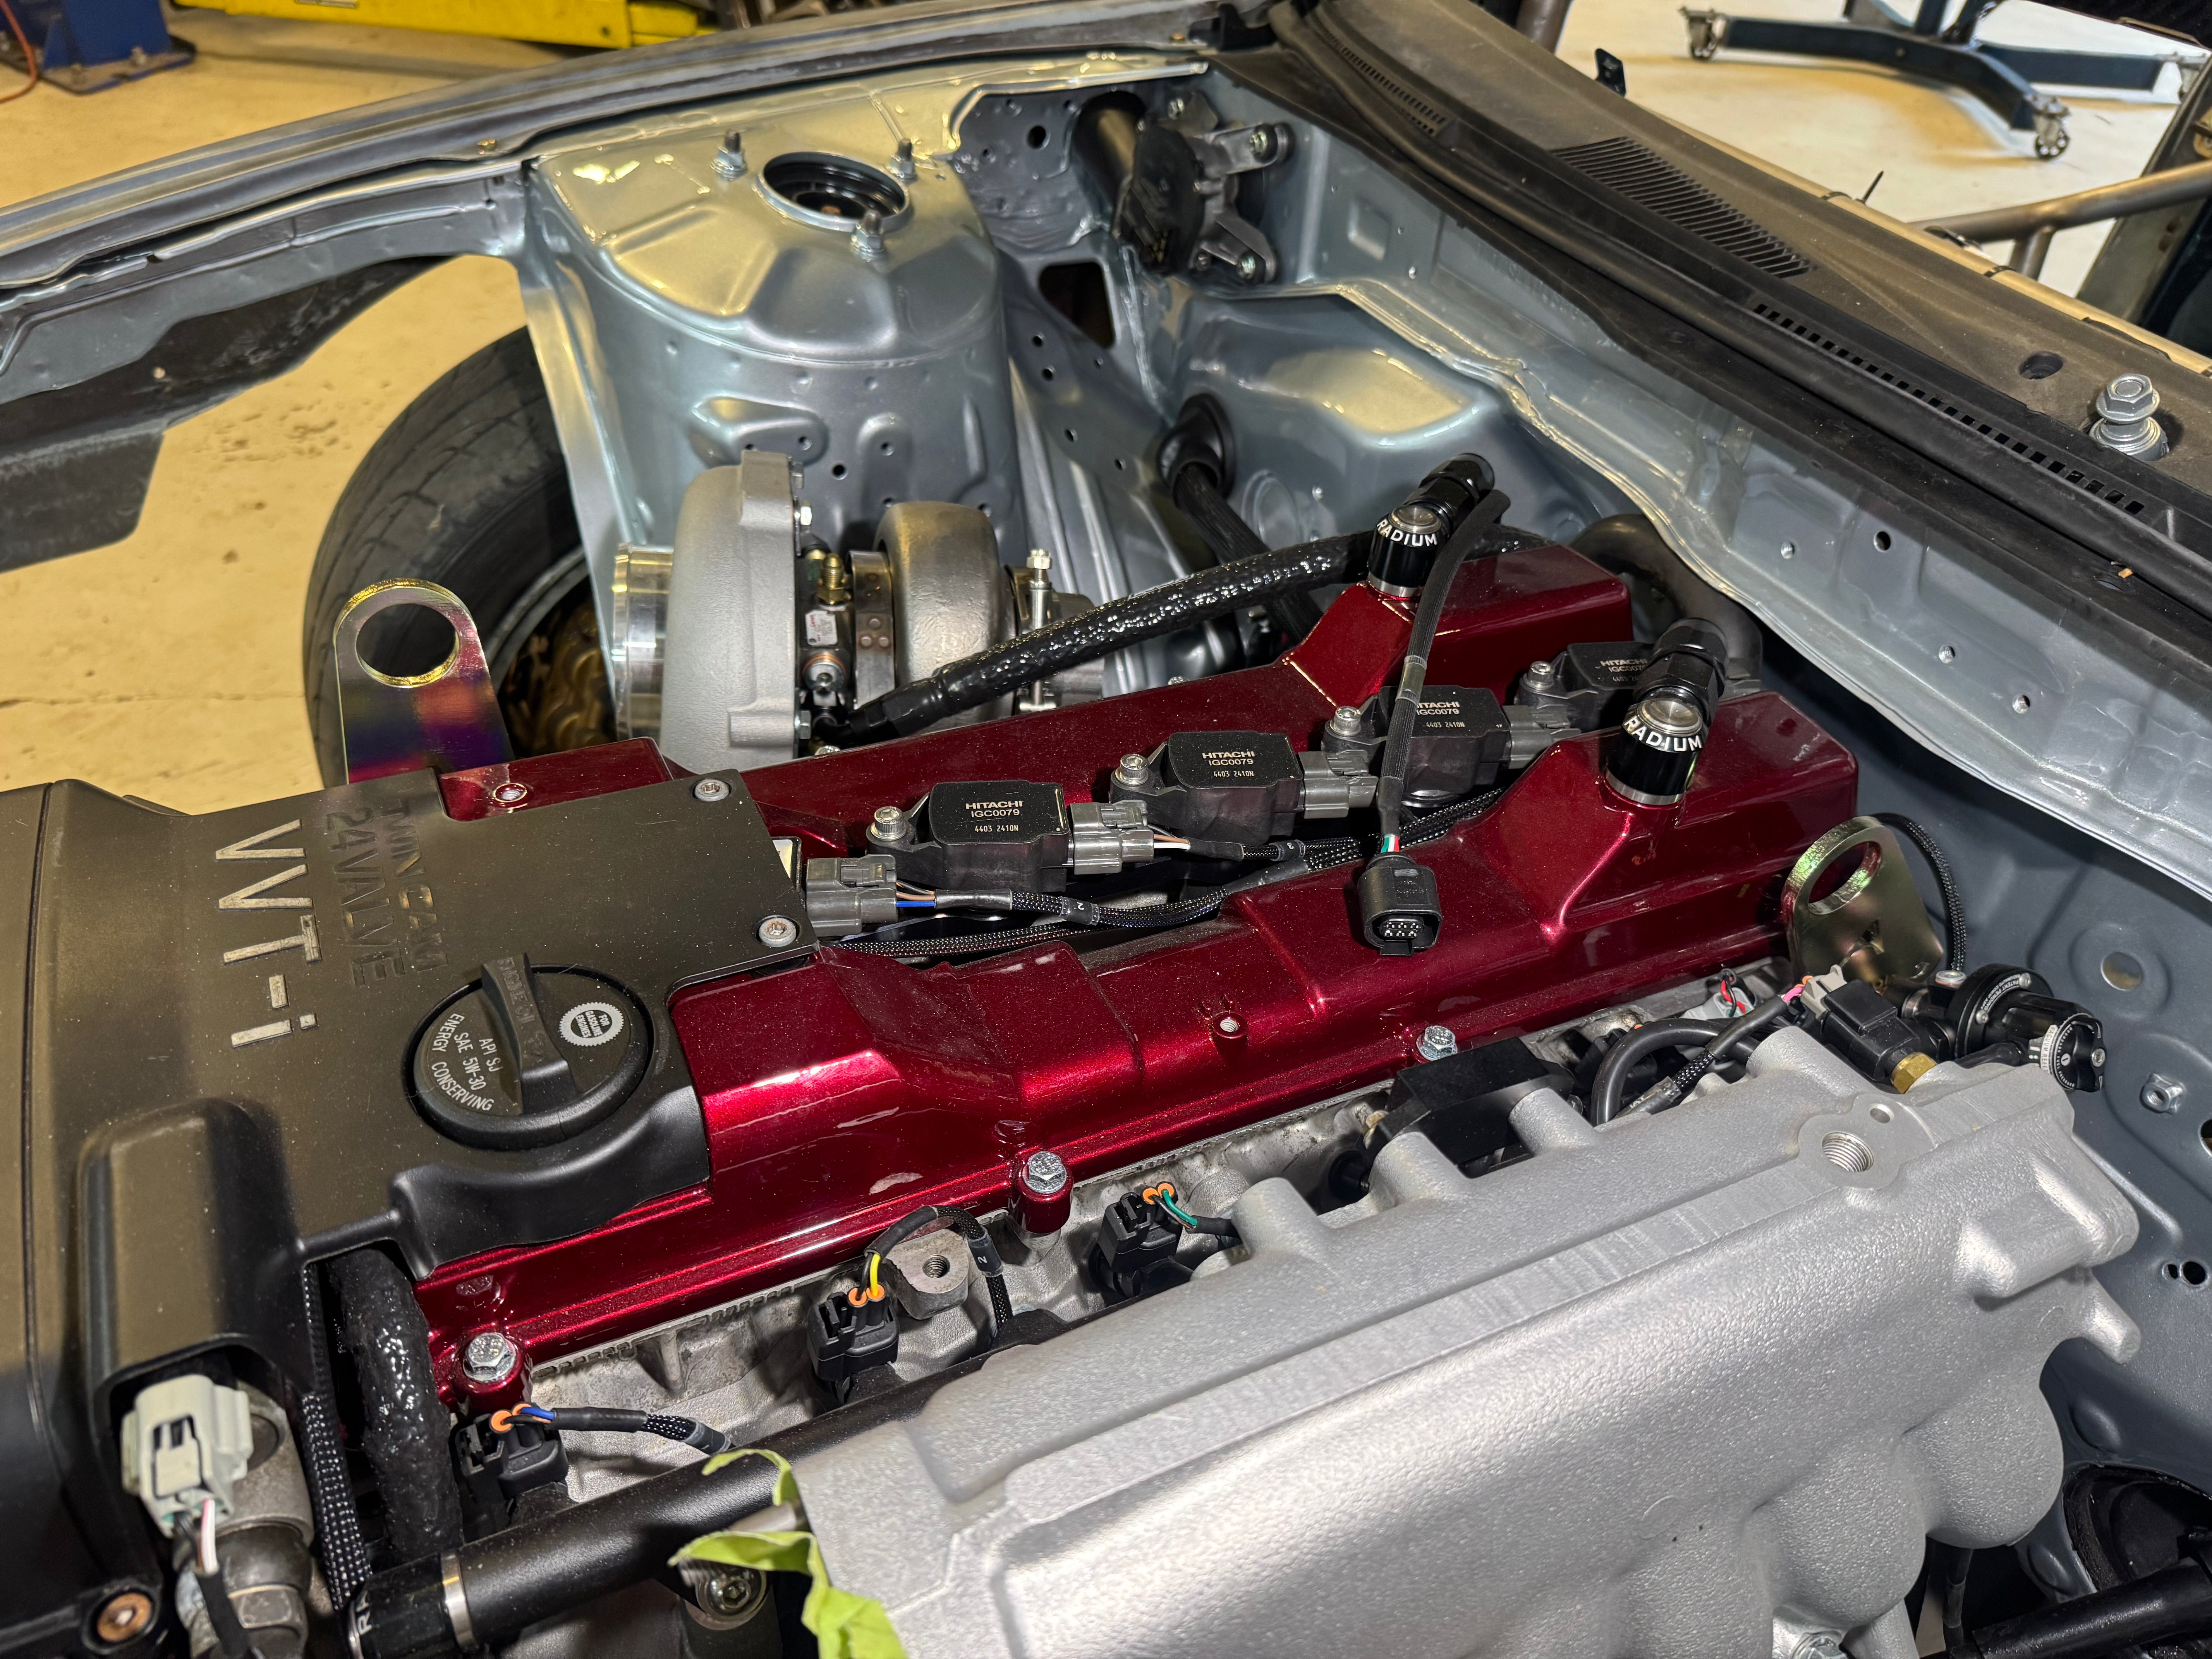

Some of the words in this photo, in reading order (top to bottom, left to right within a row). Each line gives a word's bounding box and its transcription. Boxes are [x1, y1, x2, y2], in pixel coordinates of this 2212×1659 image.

[1377, 519, 1437, 547] RADIUM
[1624, 715, 1702, 752] RADIUM
[1202, 751, 1255, 759] HITACHI
[965, 800, 1023, 810] HITACHI
[971, 809, 1020, 817] IGC0079
[1076, 902, 1085, 910] 2
[215, 819, 323, 1048] VVT-i
[398, 884, 449, 973] CAM
[2002, 979, 2020, 991] PATENT
[1984, 988, 2002, 1011] PENDING
[432, 1013, 465, 1052] ENERGY
[575, 1014, 592, 1038] ENGINES
[585, 1010, 603, 1037] GASOLINE
[598, 1014, 610, 1027] FOR
[453, 1032, 474, 1054] SAE
[478, 1038, 497, 1055] API
[2043, 1026, 2056, 1052] VACUUM
[462, 1057, 487, 1091] 5W-30
[486, 1057, 504, 1072] SJ
[431, 1061, 494, 1111] CONSERVING
[355, 1589, 373, 1636] RA
